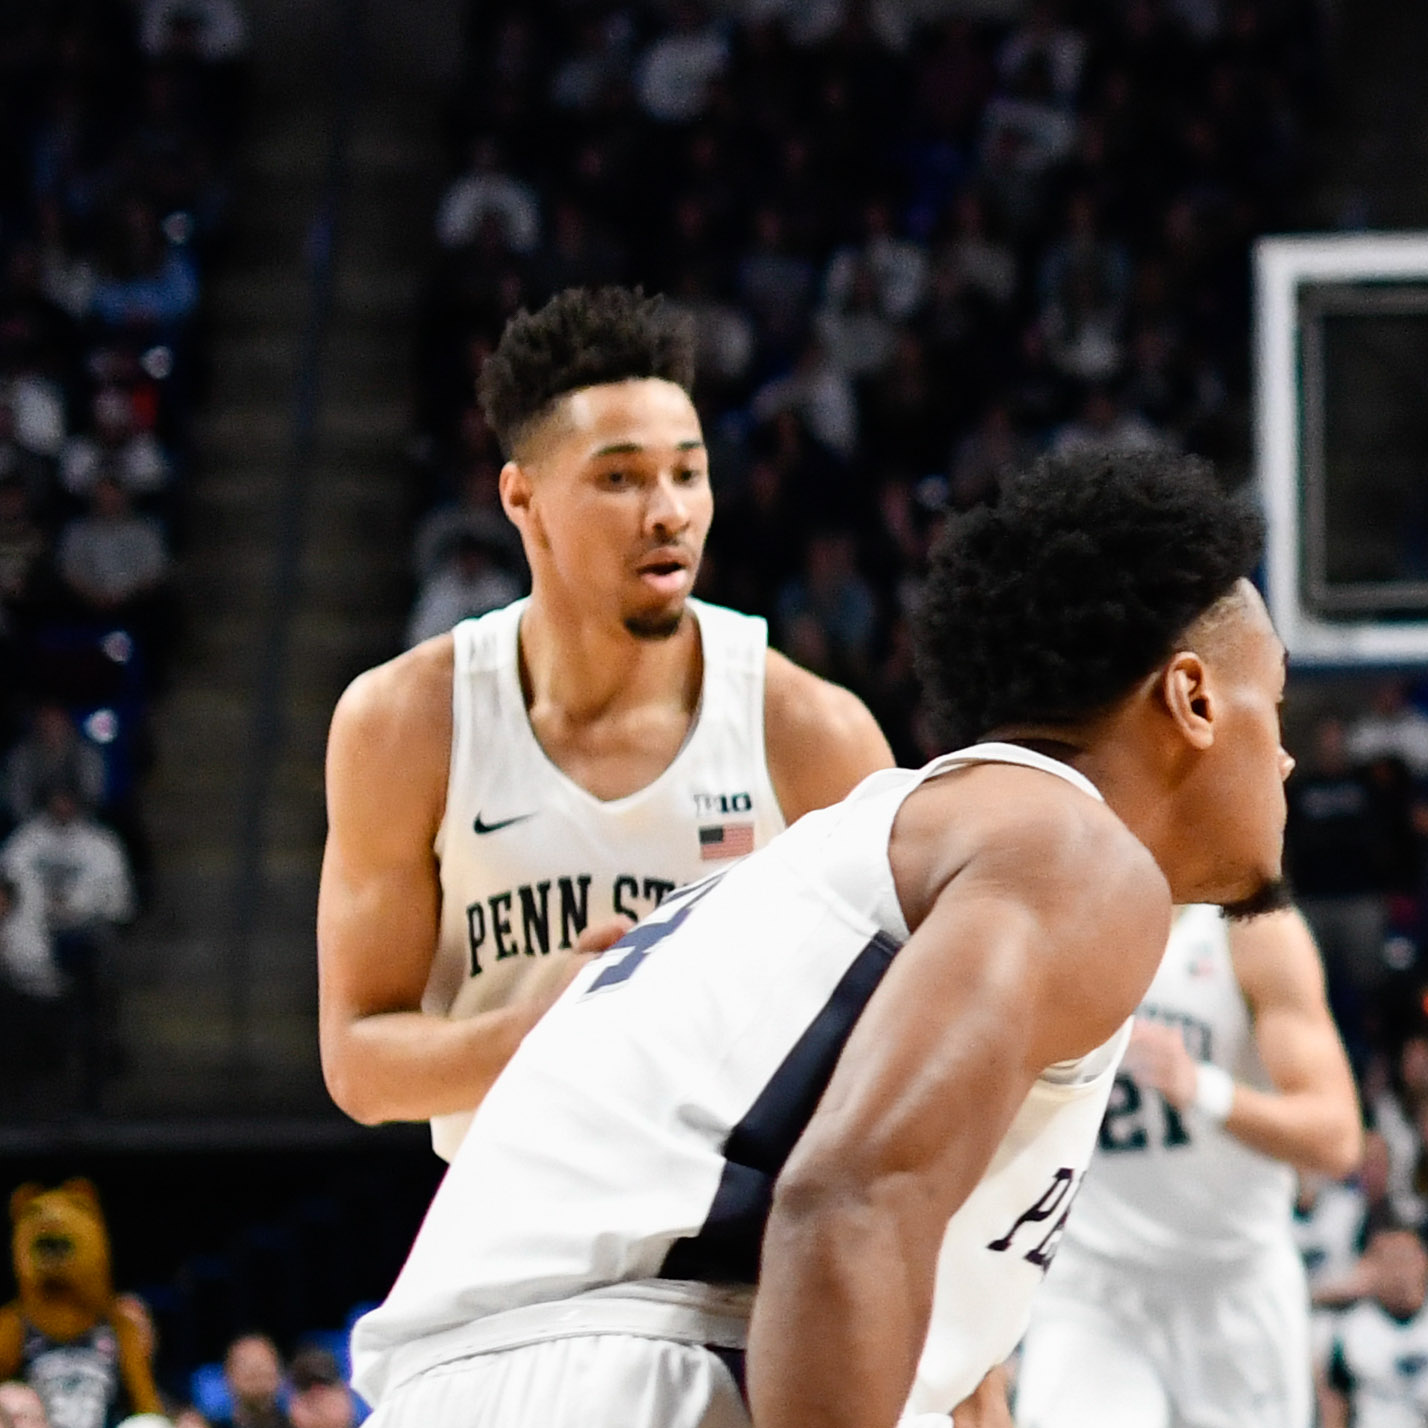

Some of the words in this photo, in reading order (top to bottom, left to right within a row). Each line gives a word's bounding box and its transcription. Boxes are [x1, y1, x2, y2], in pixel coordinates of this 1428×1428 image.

[466, 873, 593, 978] PENN
[612, 873, 692, 925] ST
[1099, 1070, 1190, 1153] 21
